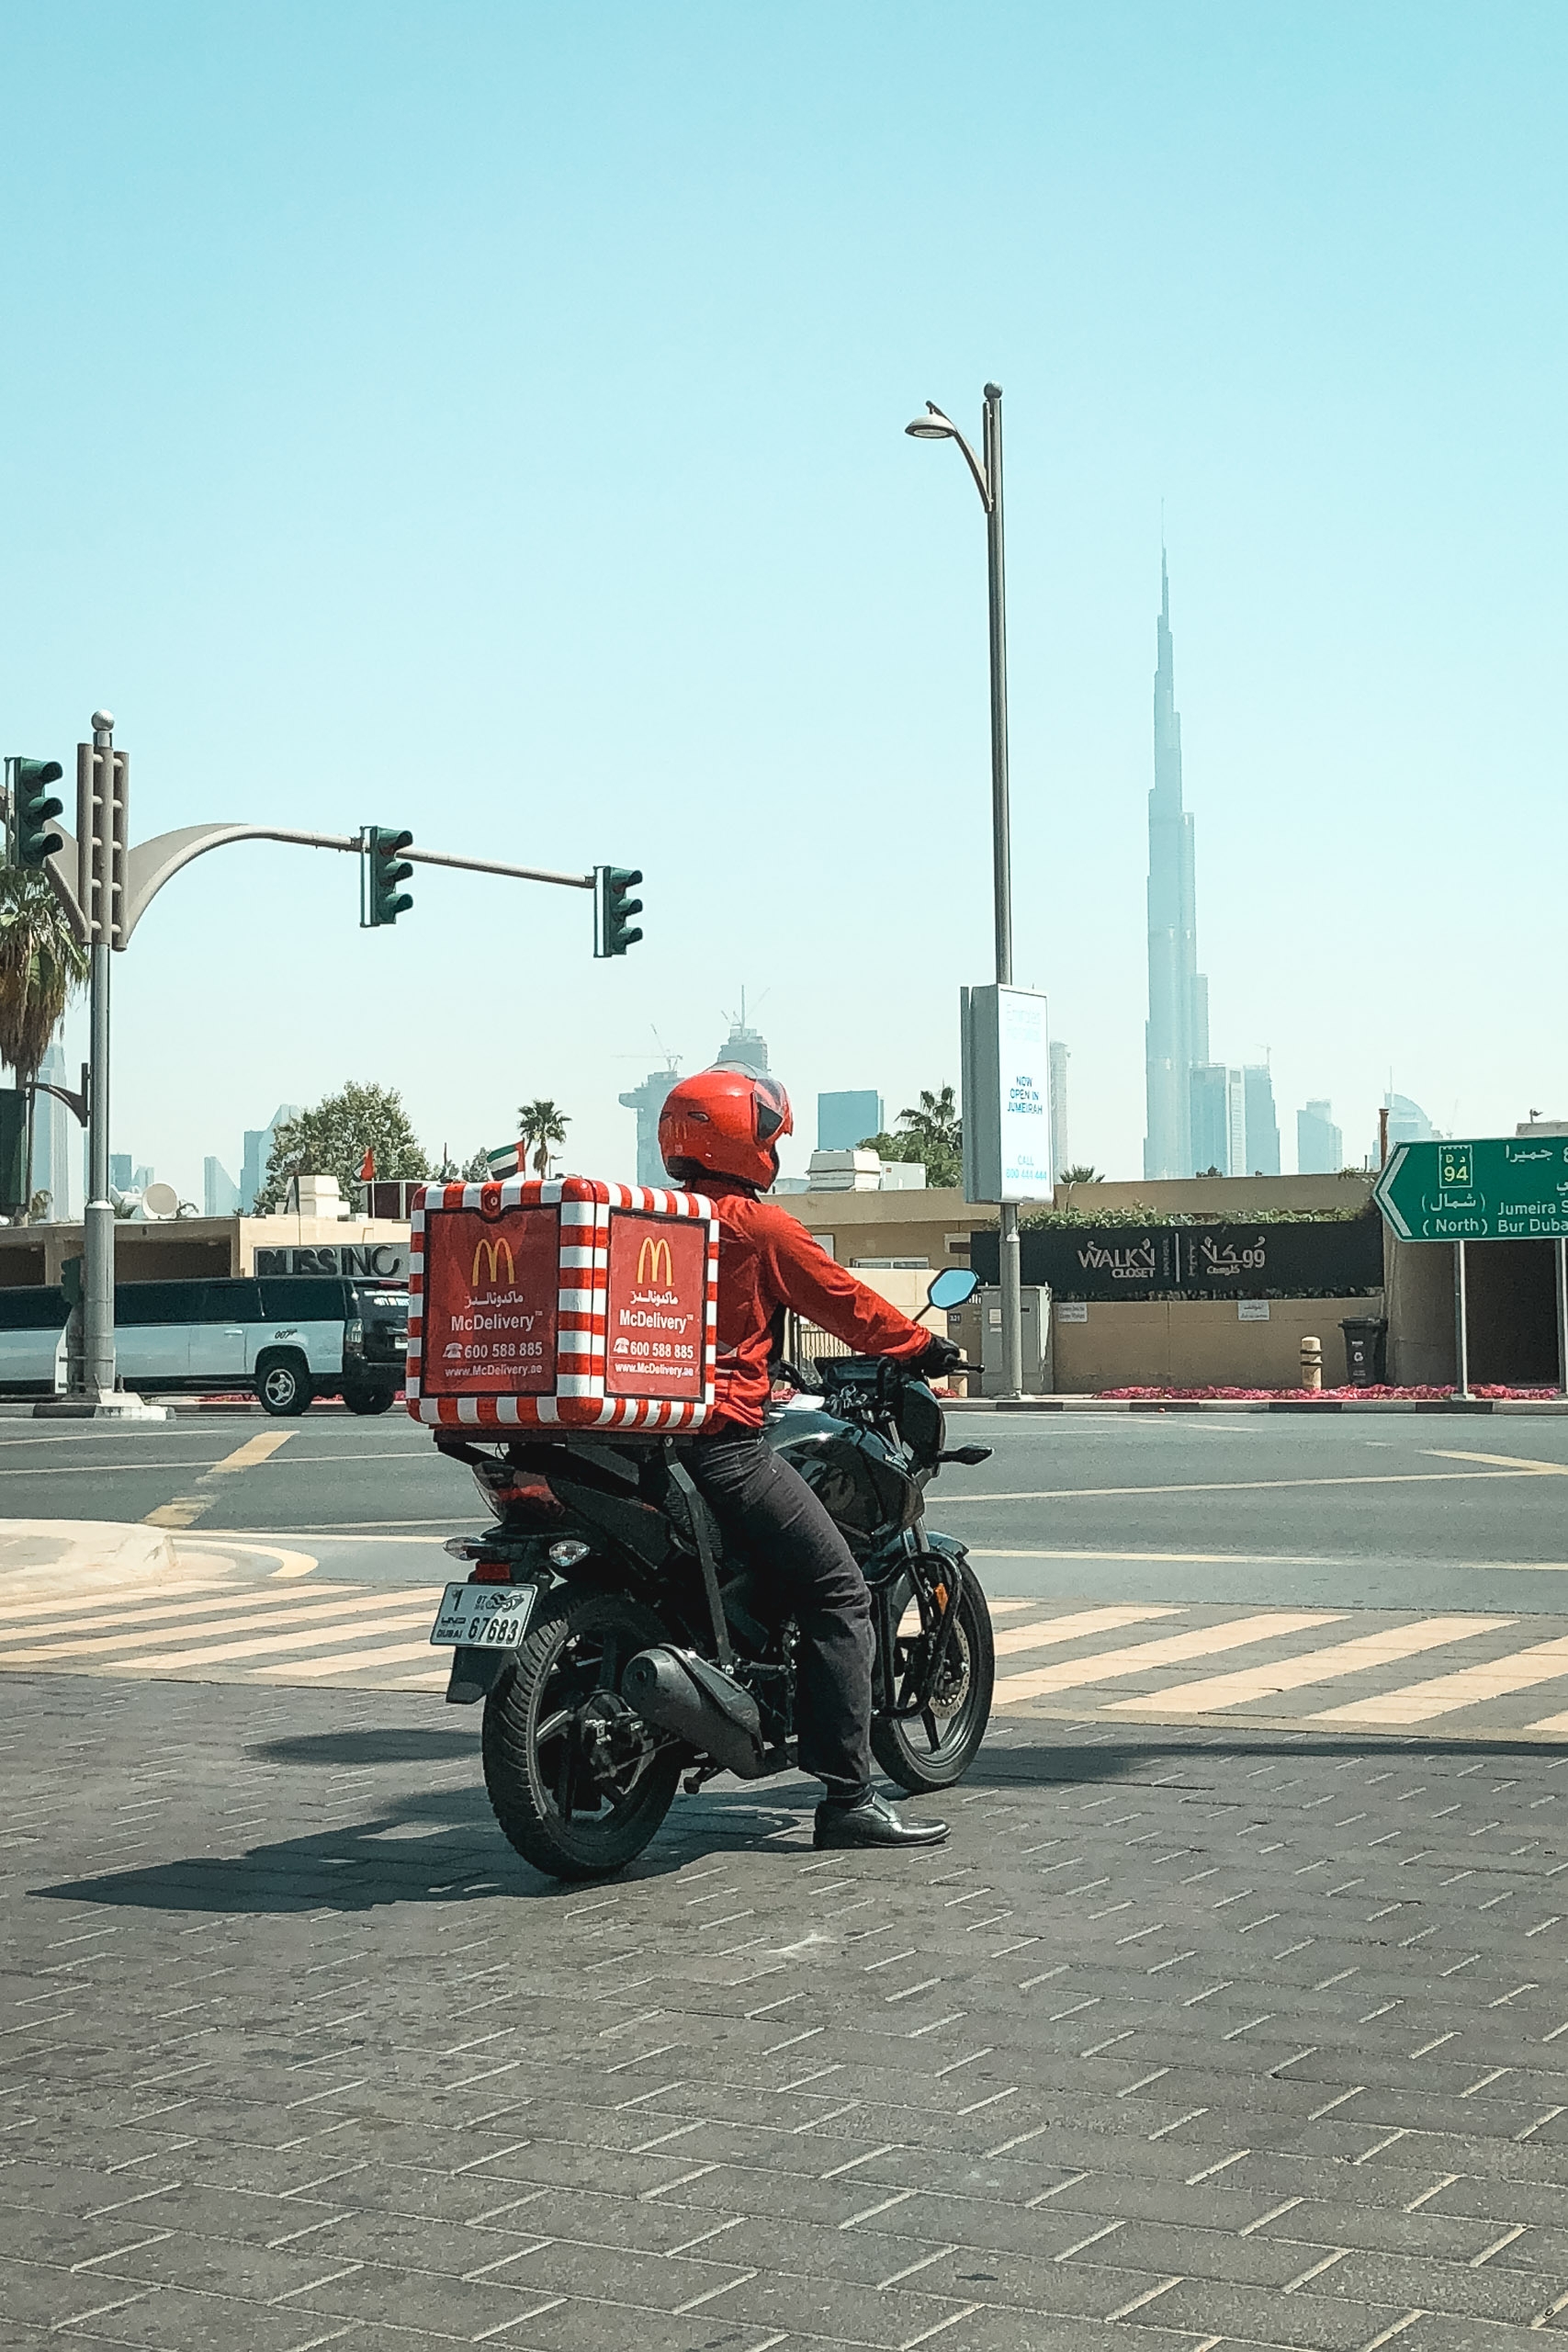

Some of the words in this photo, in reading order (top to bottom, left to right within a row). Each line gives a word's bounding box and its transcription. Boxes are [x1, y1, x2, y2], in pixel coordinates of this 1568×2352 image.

[1016, 1076, 1032, 1087] NOW
[1010, 1088, 1030, 1100] OPEN
[1032, 1091, 1040, 1101] IN
[1007, 1102, 1043, 1114] JUMEIRAH
[1446, 1154, 1454, 1163] D
[1506, 1145, 1553, 1163] جميرا
[1444, 1166, 1469, 1182] 94
[1497, 1201, 1557, 1216] Jumeira
[1498, 1219, 1525, 1233] Bur
[341, 1246, 400, 1277] INC
[1111, 1267, 1156, 1278] CLOSET
[464, 1344, 488, 1359] 600
[491, 1343, 515, 1357] 588
[519, 1341, 543, 1356] 885
[629, 1340, 649, 1356] 600
[652, 1342, 671, 1358] 588
[674, 1344, 694, 1360] 885
[445, 1363, 543, 1376] www.McDelivery.ae
[615, 1362, 694, 1379] www.McDelivery.ae
[453, 1589, 463, 1611] 1
[435, 1629, 464, 1640] DUBAI
[468, 1617, 519, 1645] 67683
